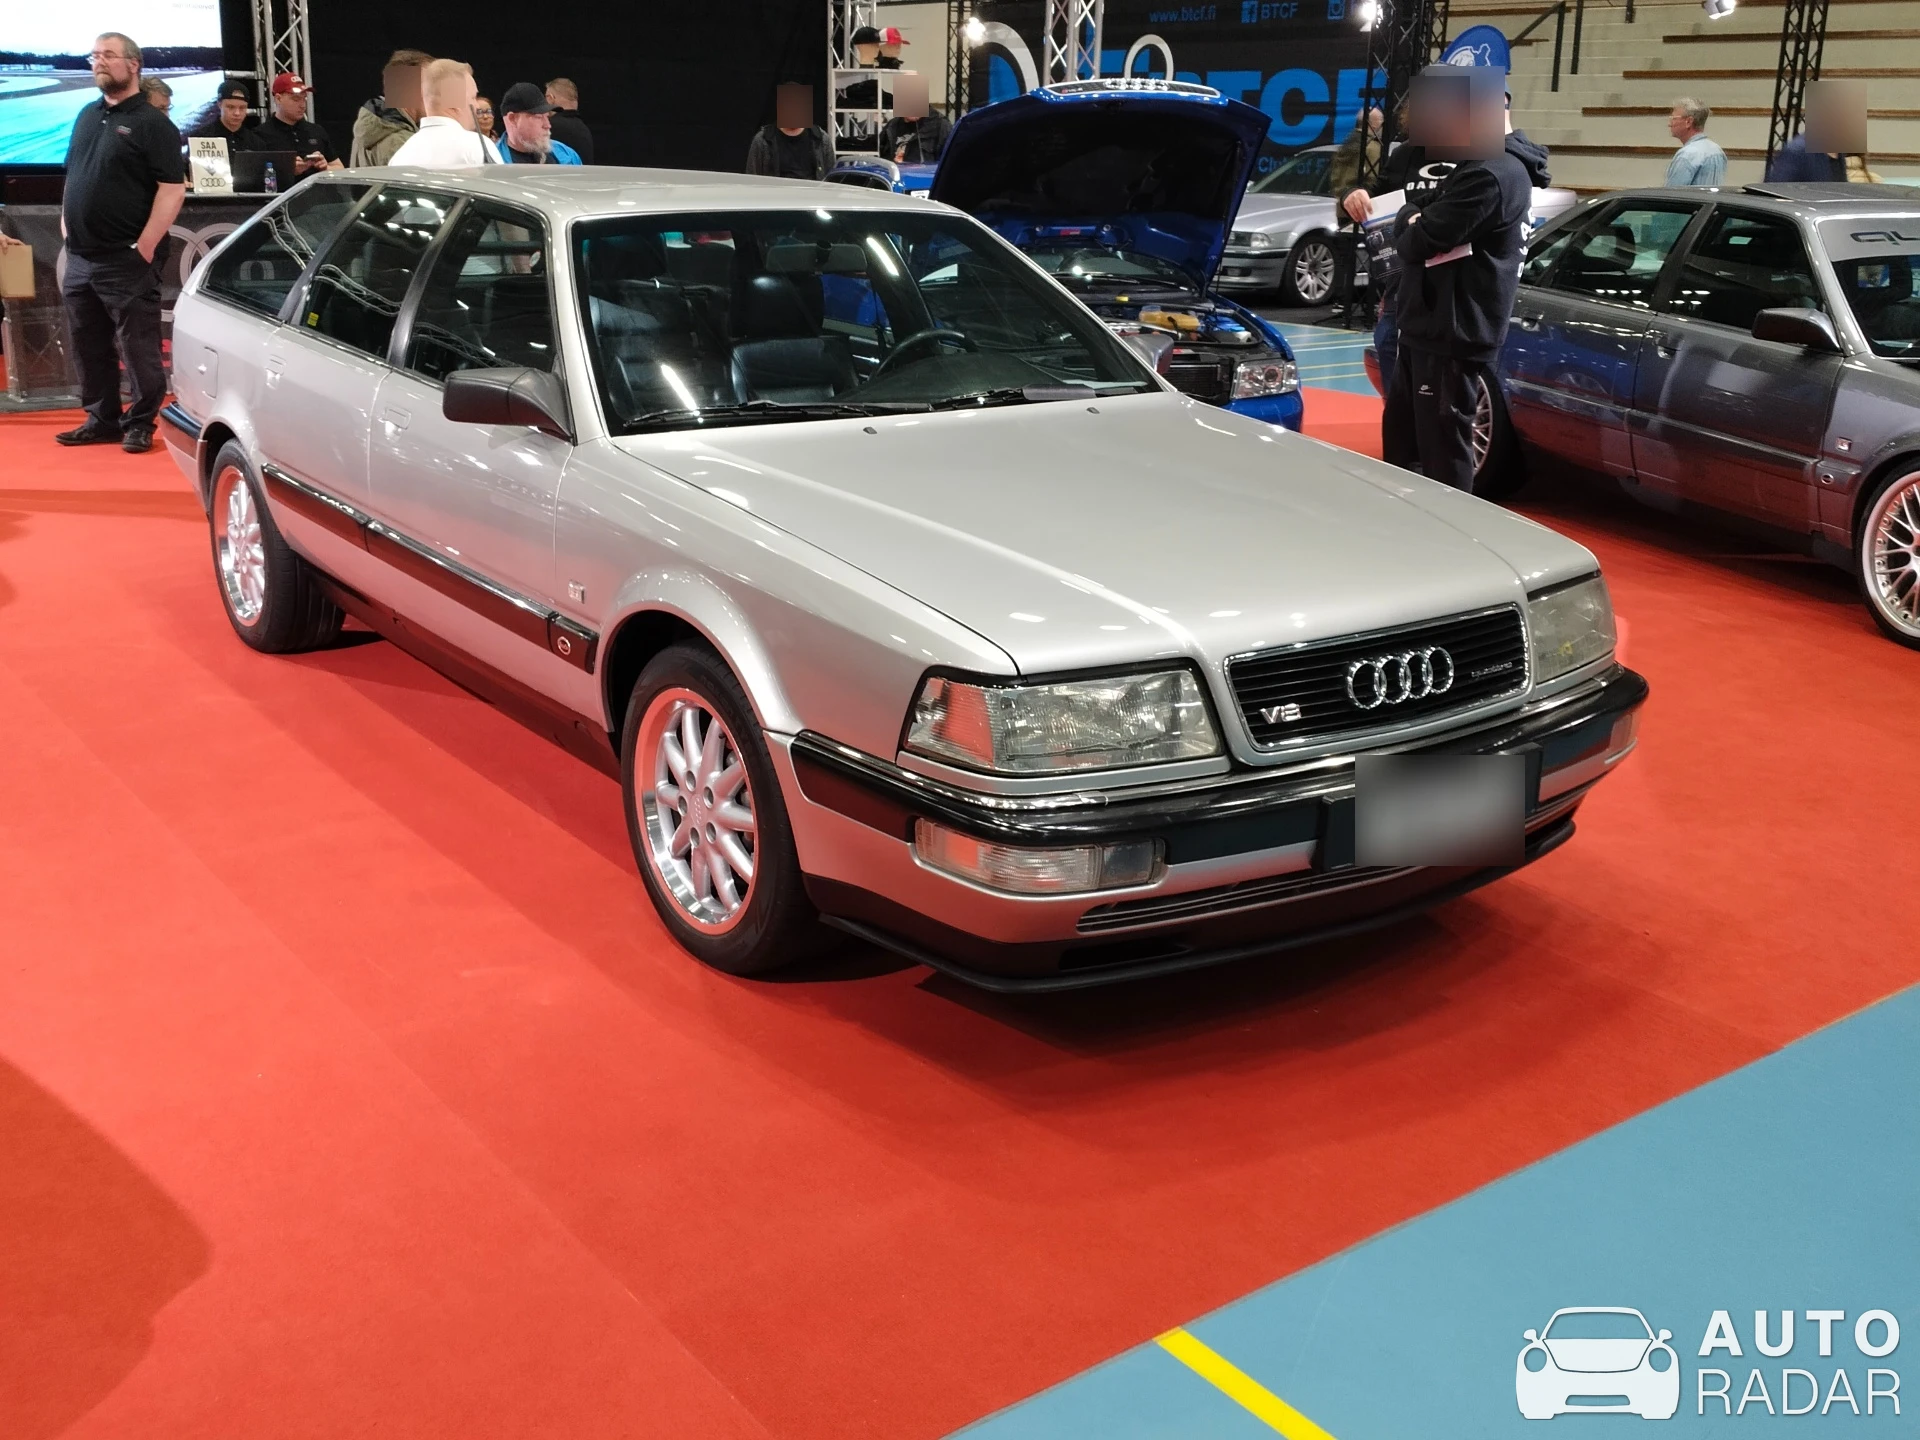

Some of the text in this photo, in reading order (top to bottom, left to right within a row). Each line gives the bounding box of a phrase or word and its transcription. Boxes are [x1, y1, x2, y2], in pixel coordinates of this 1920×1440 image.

[1150, 6, 1217, 23] www.btcf.fi
[1261, 2, 1299, 20] BTCF
[1149, 68, 1389, 146] TCF
[196, 149, 225, 158] OTTAA!
[200, 141, 217, 150] SAA
[1260, 703, 1302, 724] V8
